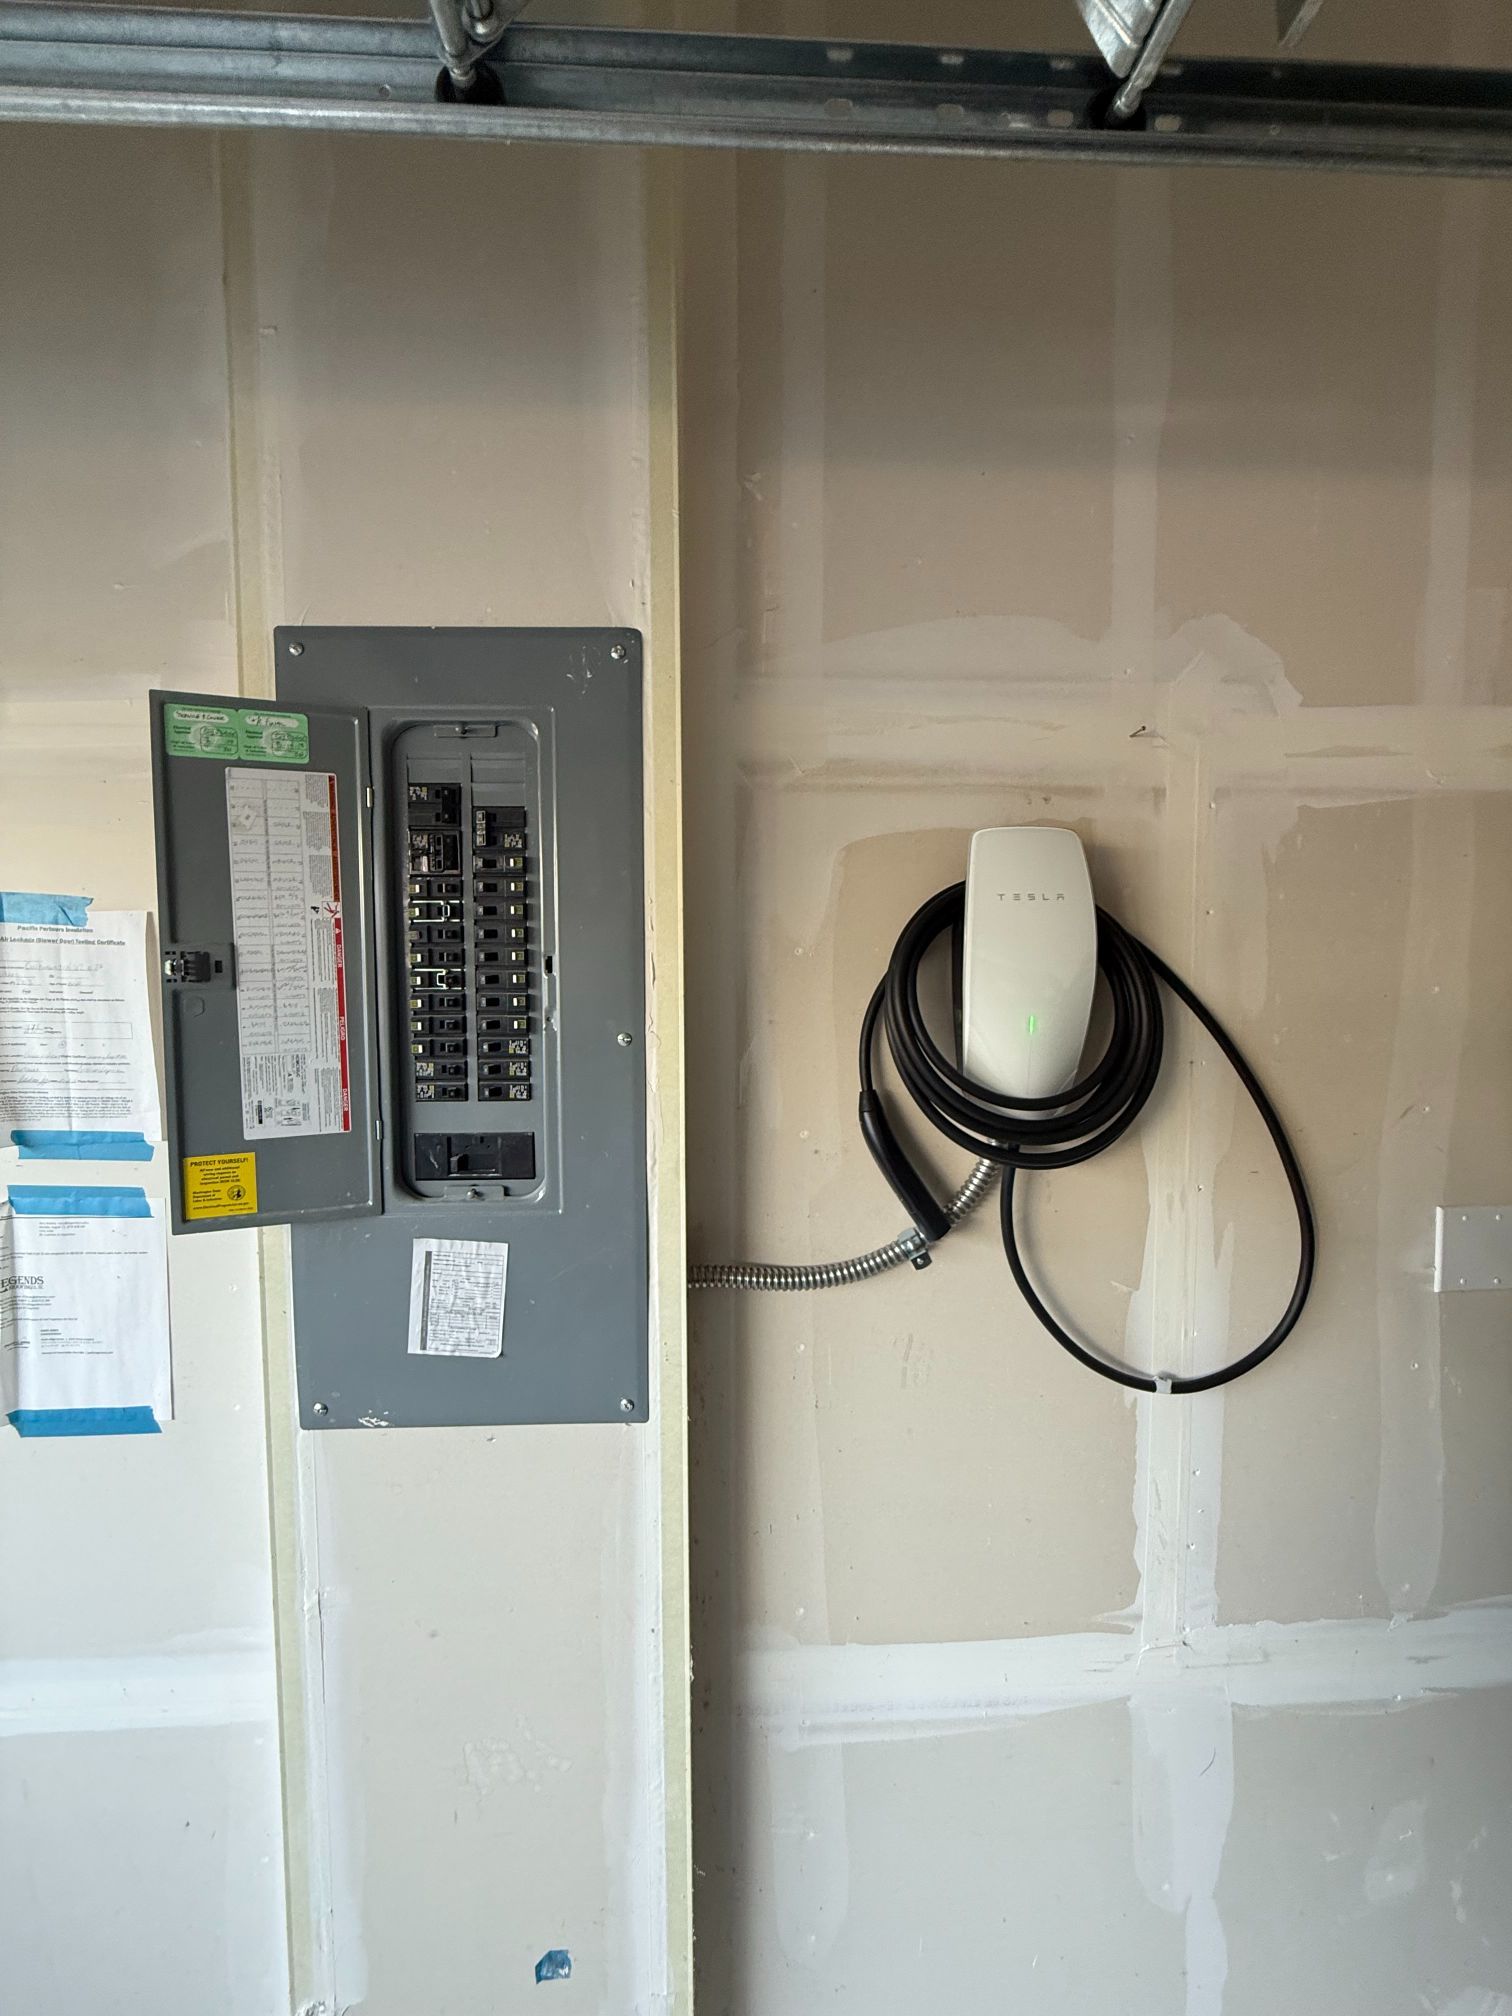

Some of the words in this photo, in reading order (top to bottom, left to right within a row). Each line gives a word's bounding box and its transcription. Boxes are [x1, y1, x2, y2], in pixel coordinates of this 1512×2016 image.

[997, 893, 1065, 901] TESLA
[190, 1159, 216, 1167] PROTECT
[217, 1157, 249, 1165] YOURSELF!
[0, 1275, 44, 1288] EGENDS
